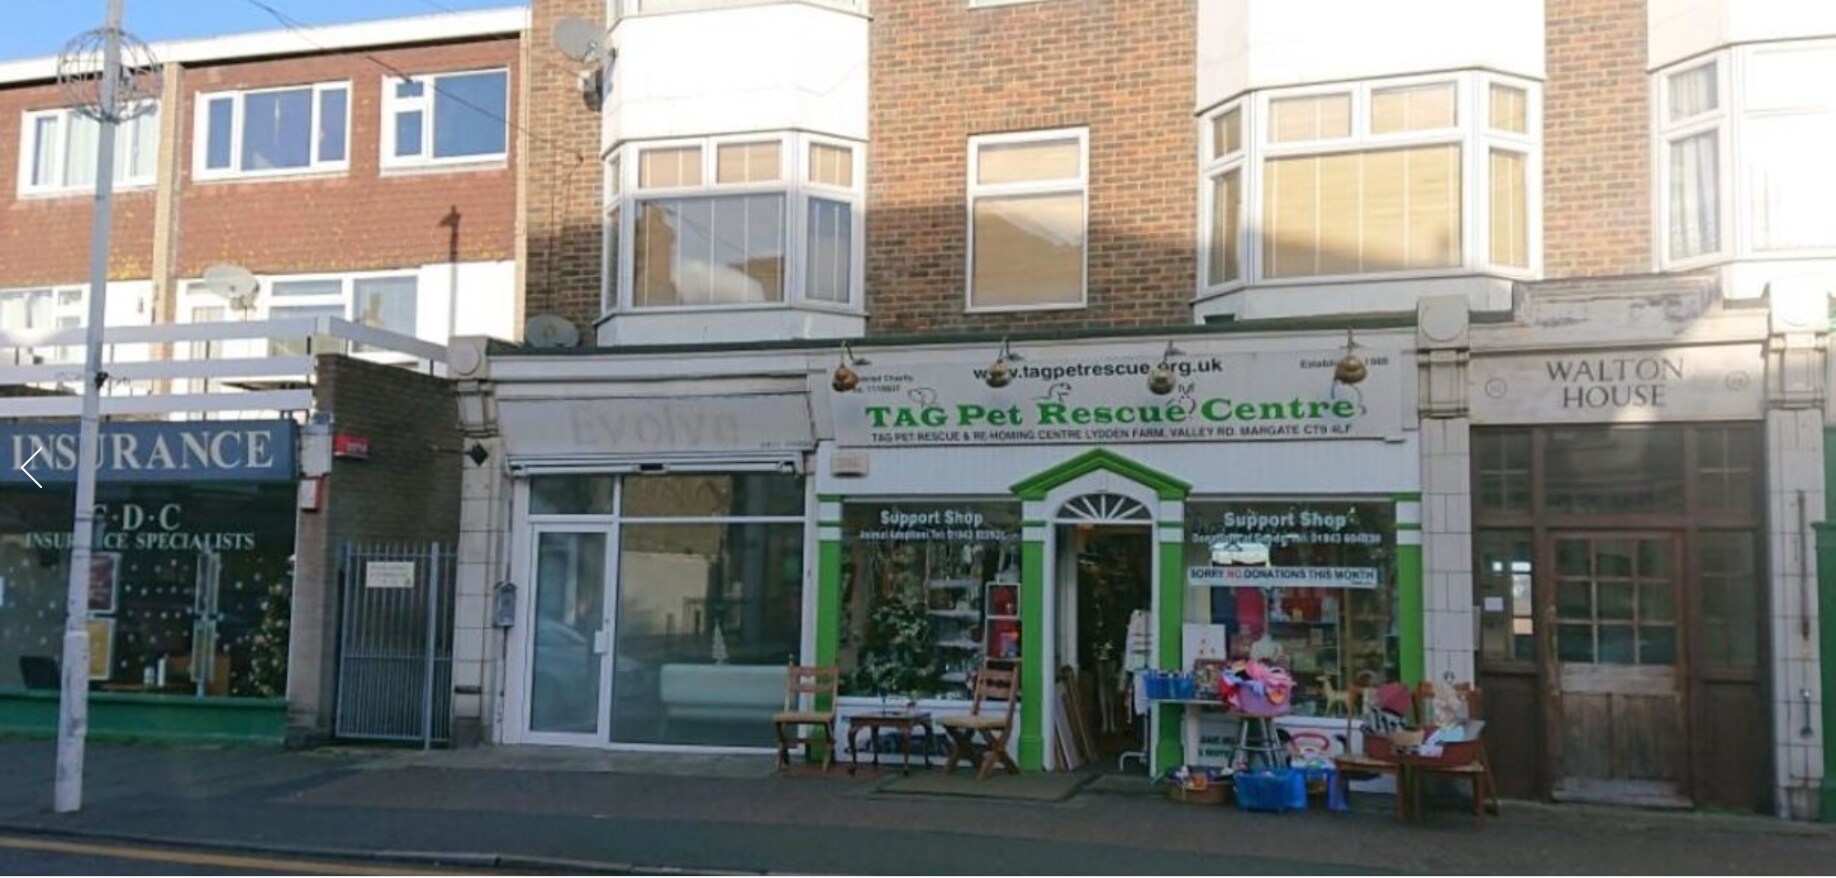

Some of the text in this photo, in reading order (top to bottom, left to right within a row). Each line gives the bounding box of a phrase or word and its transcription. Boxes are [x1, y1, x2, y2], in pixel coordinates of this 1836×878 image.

[1546, 357, 1684, 382] WALTON
[1563, 384, 1667, 408] HOUSE
[865, 396, 1355, 428] TAG Pet Rescue Centre
[570, 403, 740, 446] Evolve
[872, 433, 893, 442] TAG
[895, 432, 916, 442] PET
[918, 431, 960, 442] RESCUE
[963, 431, 969, 441] &
[1038, 429, 1080, 440] CENTRE
[1085, 429, 1129, 439] LYDDEN
[1170, 427, 1213, 438] VALLEY
[1240, 424, 1299, 436] MARGATE
[880, 509, 983, 528] Support Shop
[1223, 511, 1346, 530] Support Shop
[137, 532, 255, 550] SPECIALISTS
[1190, 568, 1224, 579] SORRY
[1243, 568, 1307, 579] DONATIONS
[1308, 568, 1332, 579] THIS
[1334, 568, 1375, 580] MONTH
